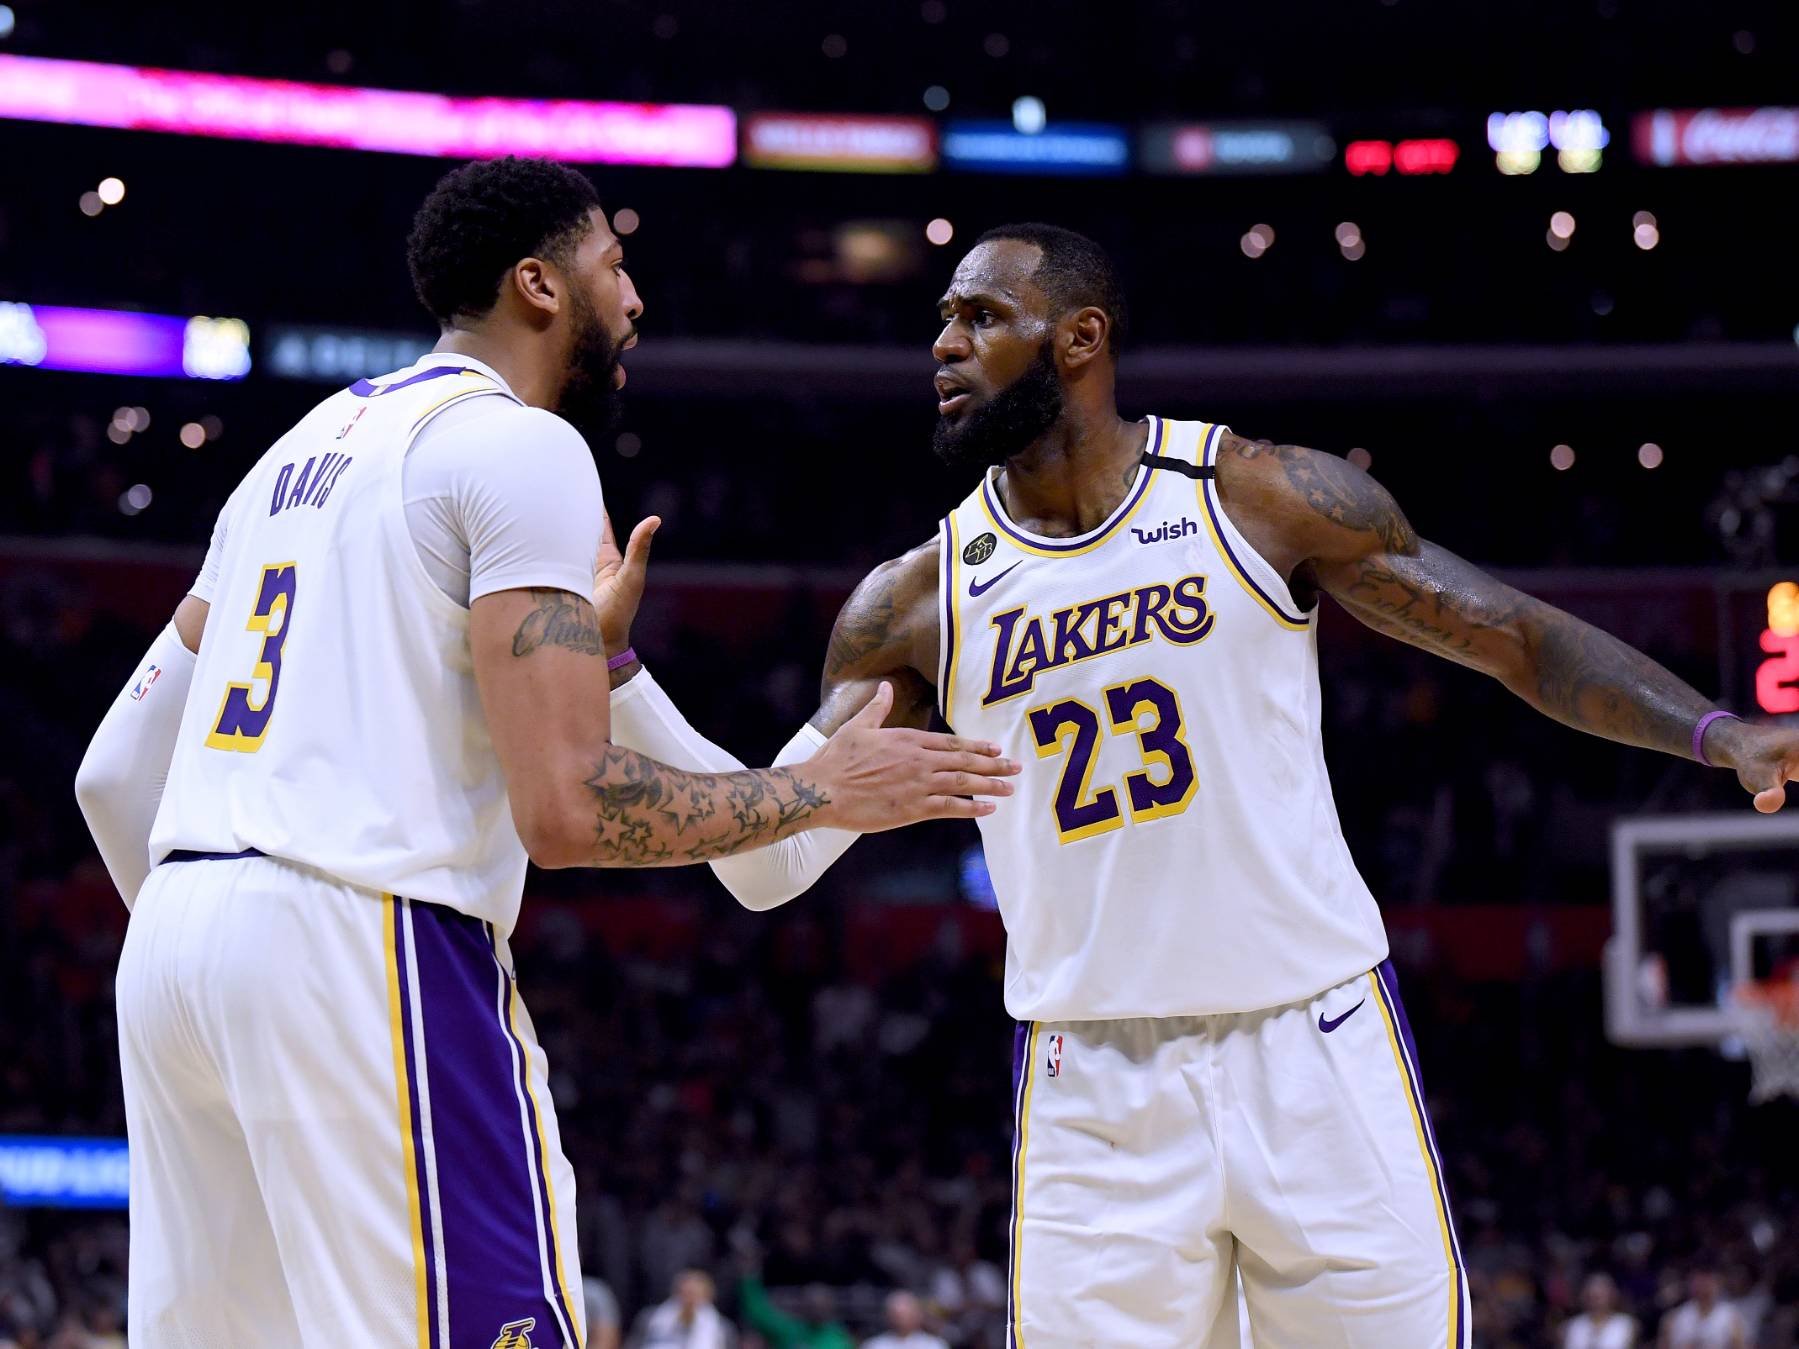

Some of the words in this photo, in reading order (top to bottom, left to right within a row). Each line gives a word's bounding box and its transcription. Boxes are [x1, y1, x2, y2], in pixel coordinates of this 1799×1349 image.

[270, 452, 352, 517] DAVIS
[1131, 517, 1198, 545] wish
[205, 562, 297, 752] 3
[981, 575, 1217, 708] LAKERS
[1026, 675, 1200, 845] 23
